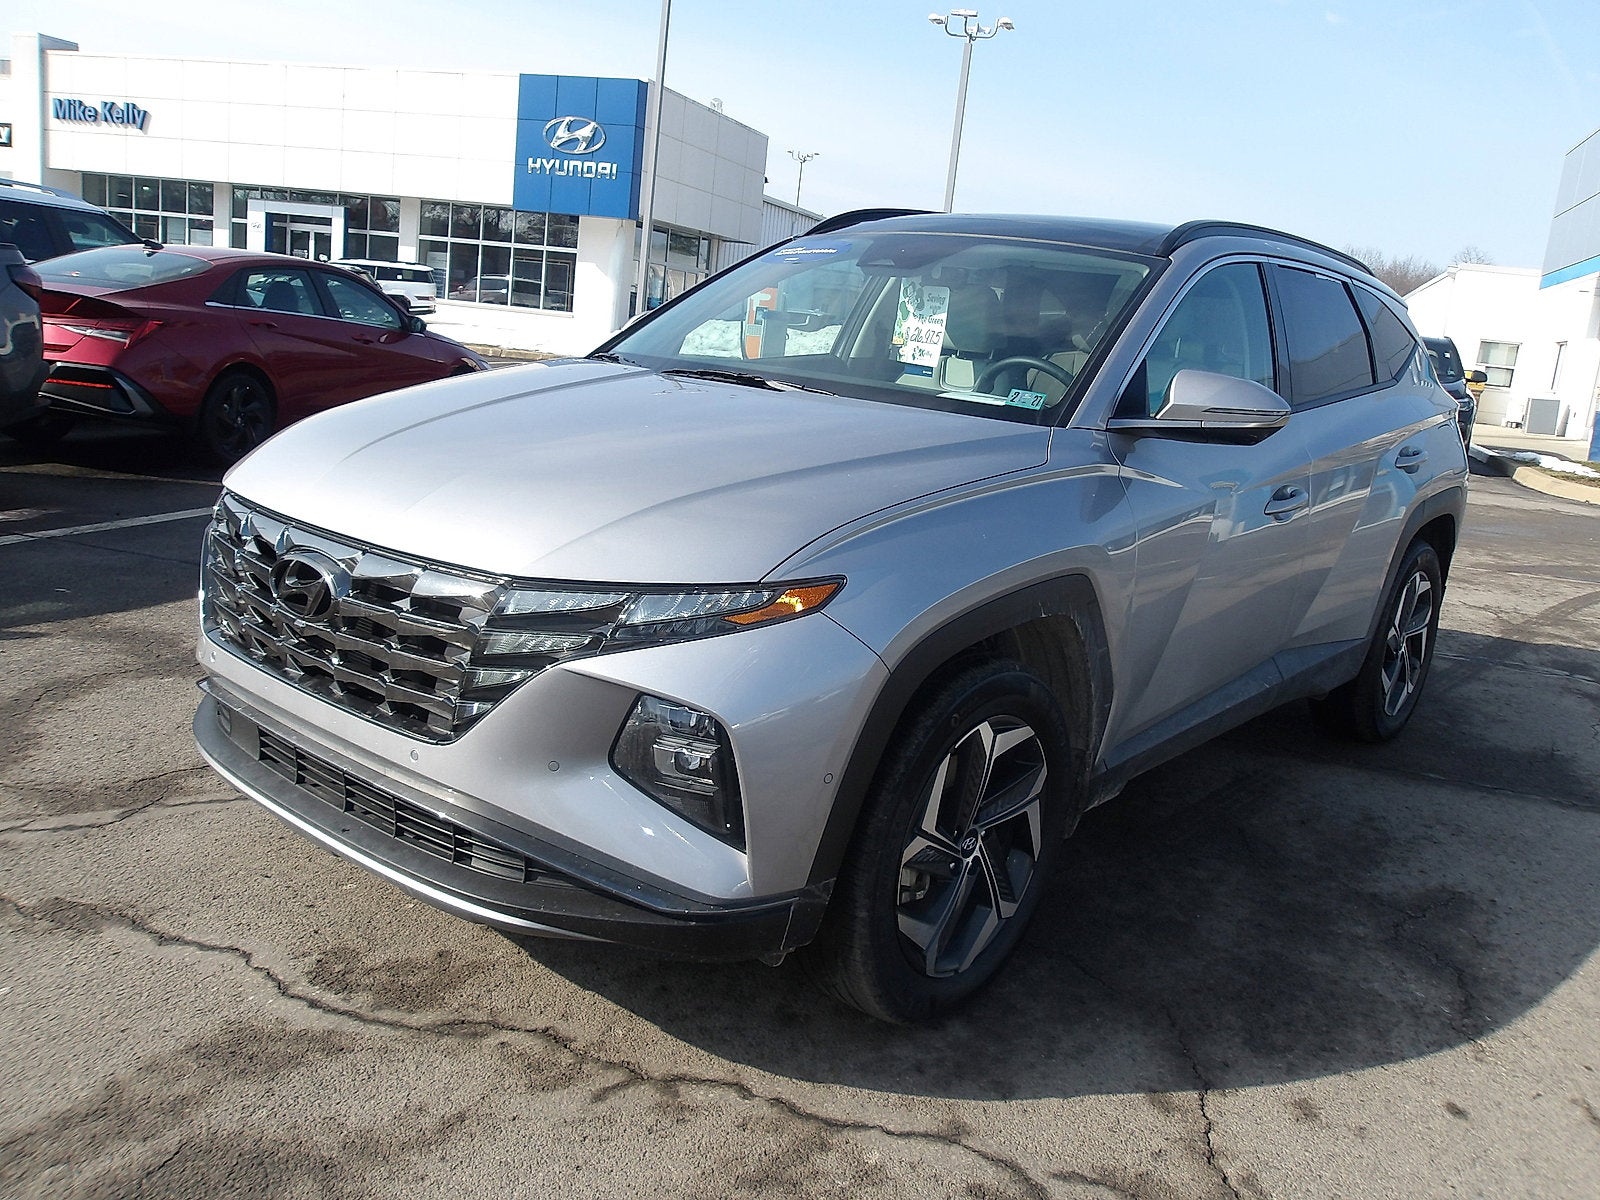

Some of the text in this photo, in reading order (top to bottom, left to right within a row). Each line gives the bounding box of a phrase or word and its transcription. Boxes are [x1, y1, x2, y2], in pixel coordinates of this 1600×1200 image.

[53, 98, 148, 130] Mike Kelly
[527, 157, 618, 179] HYUNDAI
[1010, 391, 1043, 407] 2 27
